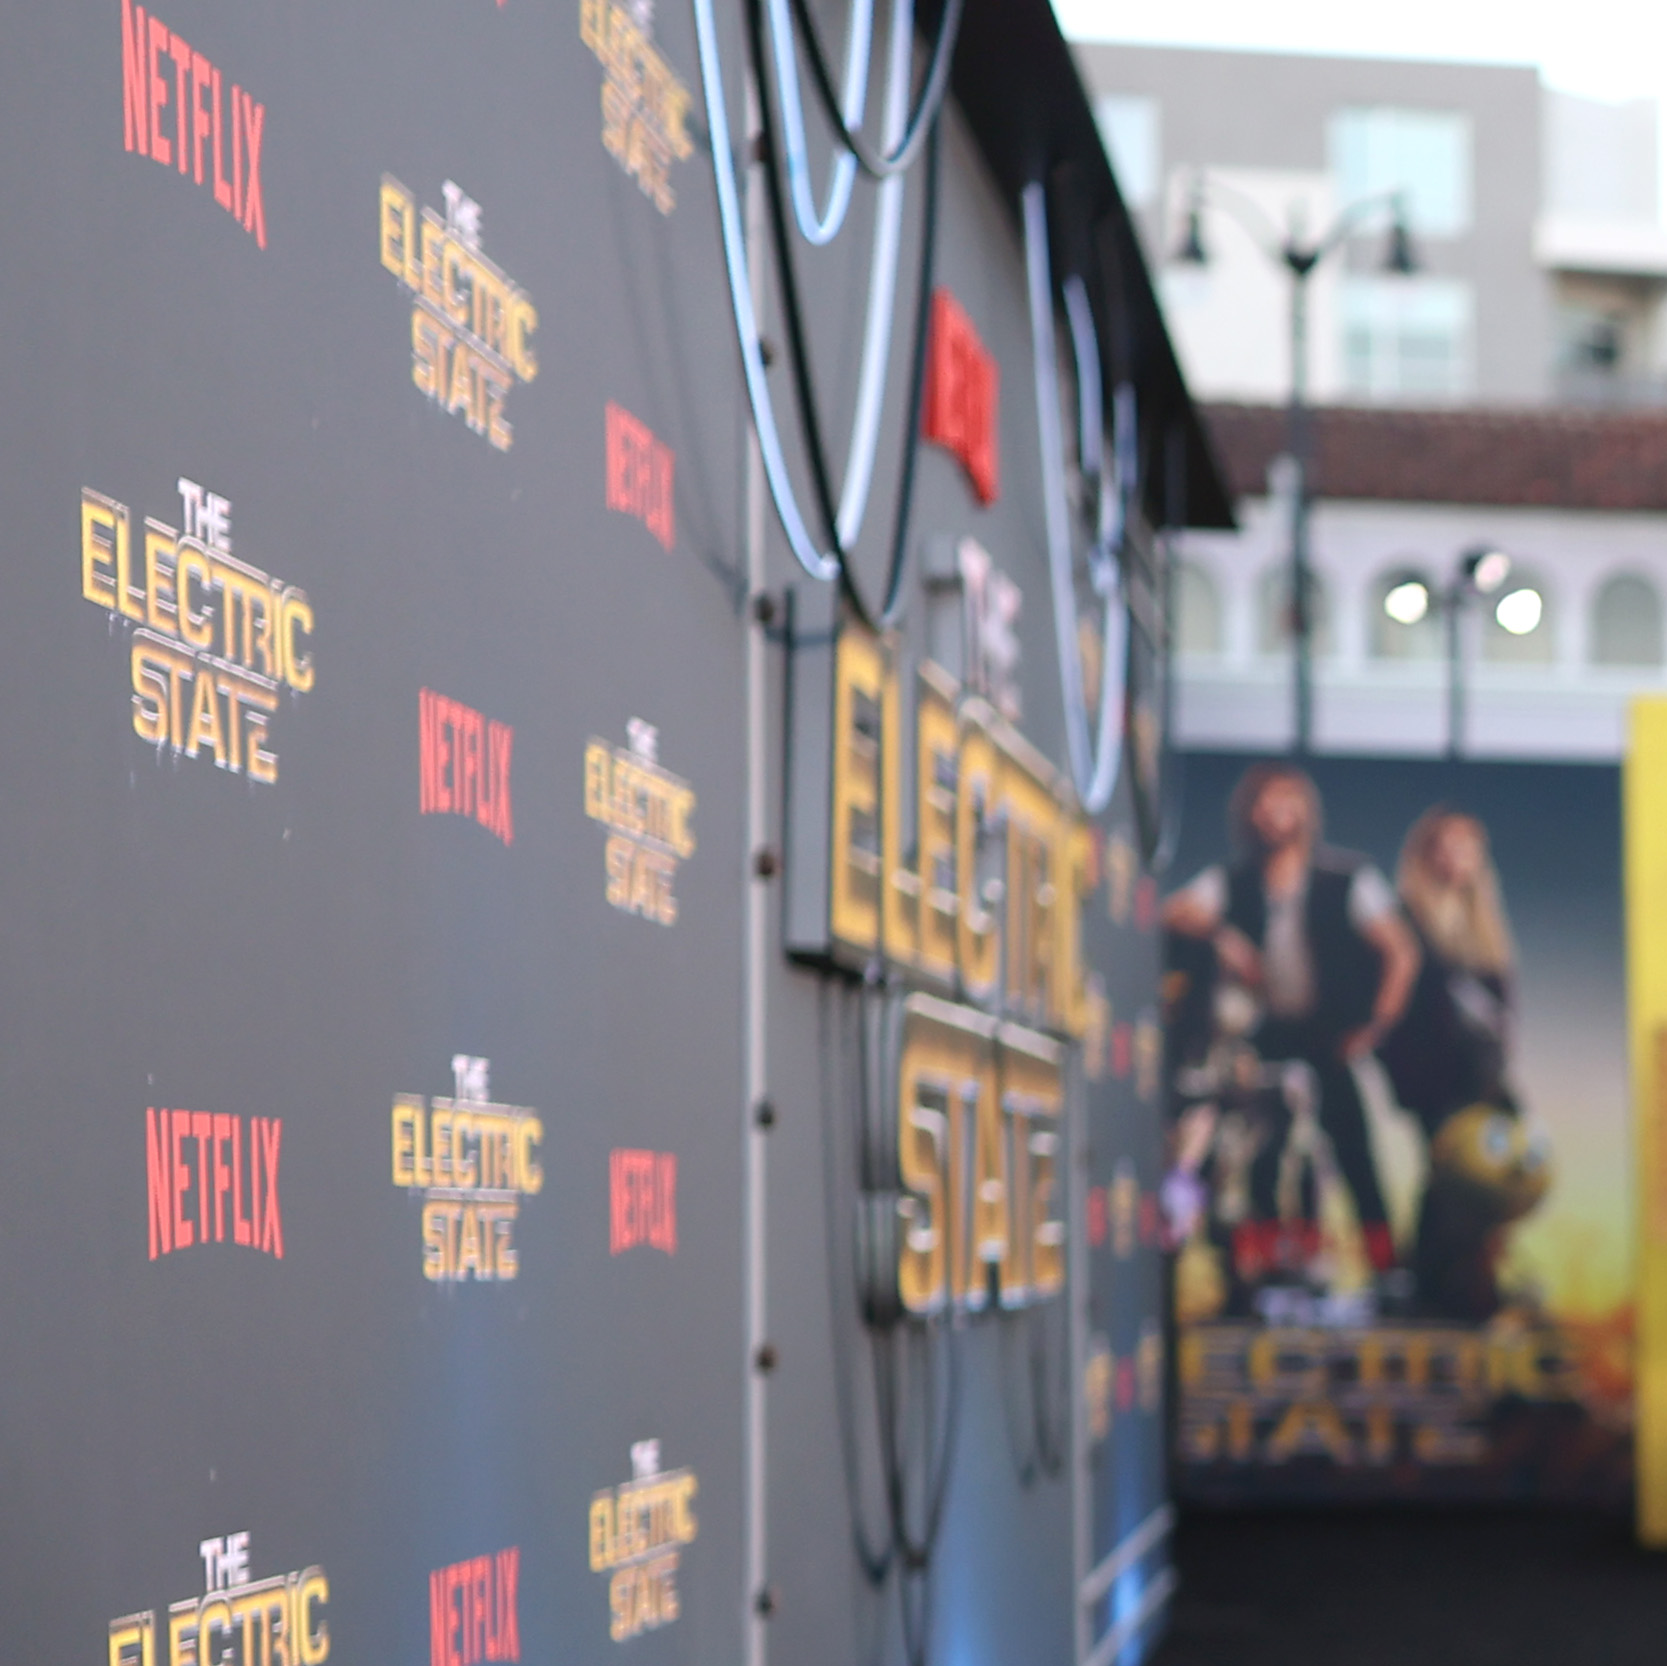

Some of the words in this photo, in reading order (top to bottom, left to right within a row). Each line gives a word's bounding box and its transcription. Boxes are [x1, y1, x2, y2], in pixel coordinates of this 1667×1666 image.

[121, 0, 266, 250] NETFLIX
[379, 175, 538, 384] ELECTRIC
[411, 303, 513, 452] STATE
[81, 488, 314, 692] ELECTRIC
[177, 476, 232, 554] THE
[131, 634, 278, 785] STATE
[419, 687, 514, 847] NETFLIX
[146, 1107, 283, 1261] NETFLIX
[391, 1094, 543, 1194] ELECTRIC
[898, 992, 1064, 1313] STATE
[421, 1197, 520, 1281] STATE
[200, 1530, 251, 1592] THE
